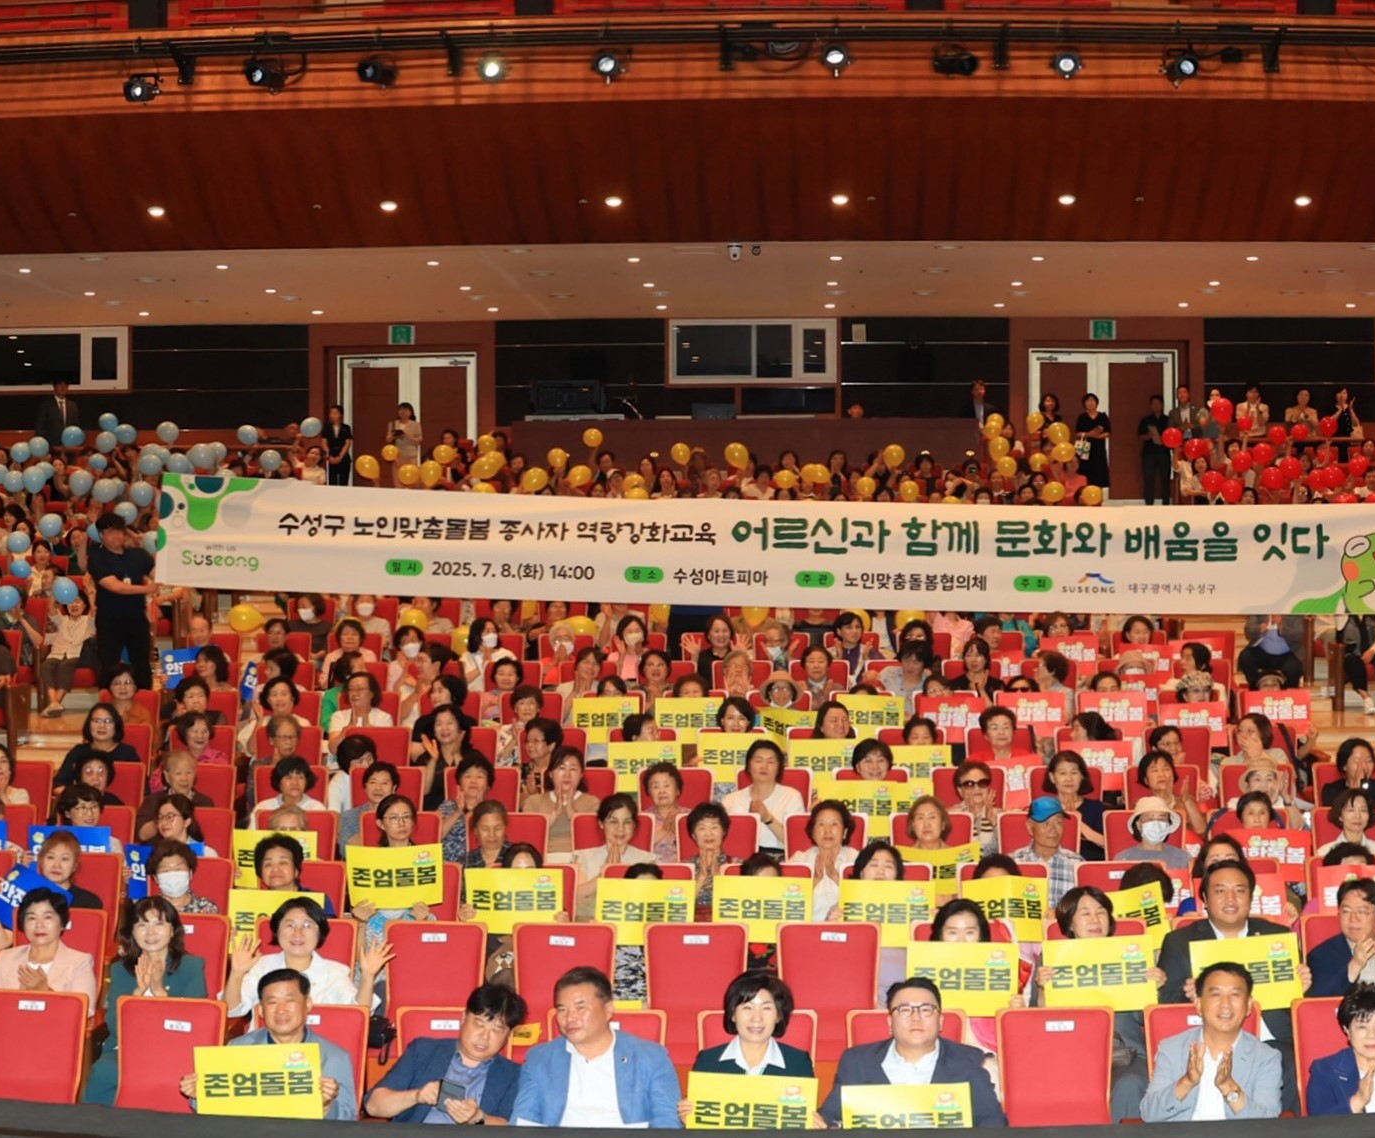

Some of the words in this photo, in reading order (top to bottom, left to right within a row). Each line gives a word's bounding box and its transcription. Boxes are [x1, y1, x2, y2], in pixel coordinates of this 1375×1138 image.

[278, 513, 345, 537] 수성구
[353, 515, 491, 540] 노인맞춤돌봄
[498, 519, 569, 541] 종사자
[577, 521, 716, 546] 역량강화교육
[731, 516, 892, 554] 어르신과
[901, 516, 980, 557] 함께
[995, 519, 1113, 559] 문화와
[1124, 521, 1239, 562] 배움을
[1252, 522, 1330, 561] 잇다
[181, 549, 259, 572] Suseong
[431, 561, 477, 577] 2025.
[481, 562, 496, 578] 7.
[549, 565, 596, 581] 14:00
[673, 568, 768, 586] 수성아트피아
[843, 571, 987, 591] 노인맞춤돌봄협의체
[1062, 585, 1116, 594] SUSEONG
[1128, 583, 1182, 594] 대구광역시
[1185, 583, 1217, 595] 수성구
[352, 864, 437, 888] 존엄돌봄
[472, 889, 556, 911] 존엄돌봄
[719, 898, 806, 920] 존엄돌봄
[602, 900, 688, 923] 존엄돌봄
[843, 902, 930, 924] 존엄돌봄
[1051, 960, 1148, 989] 존엄돌봄
[204, 1070, 314, 1098] 존엄돌봄
